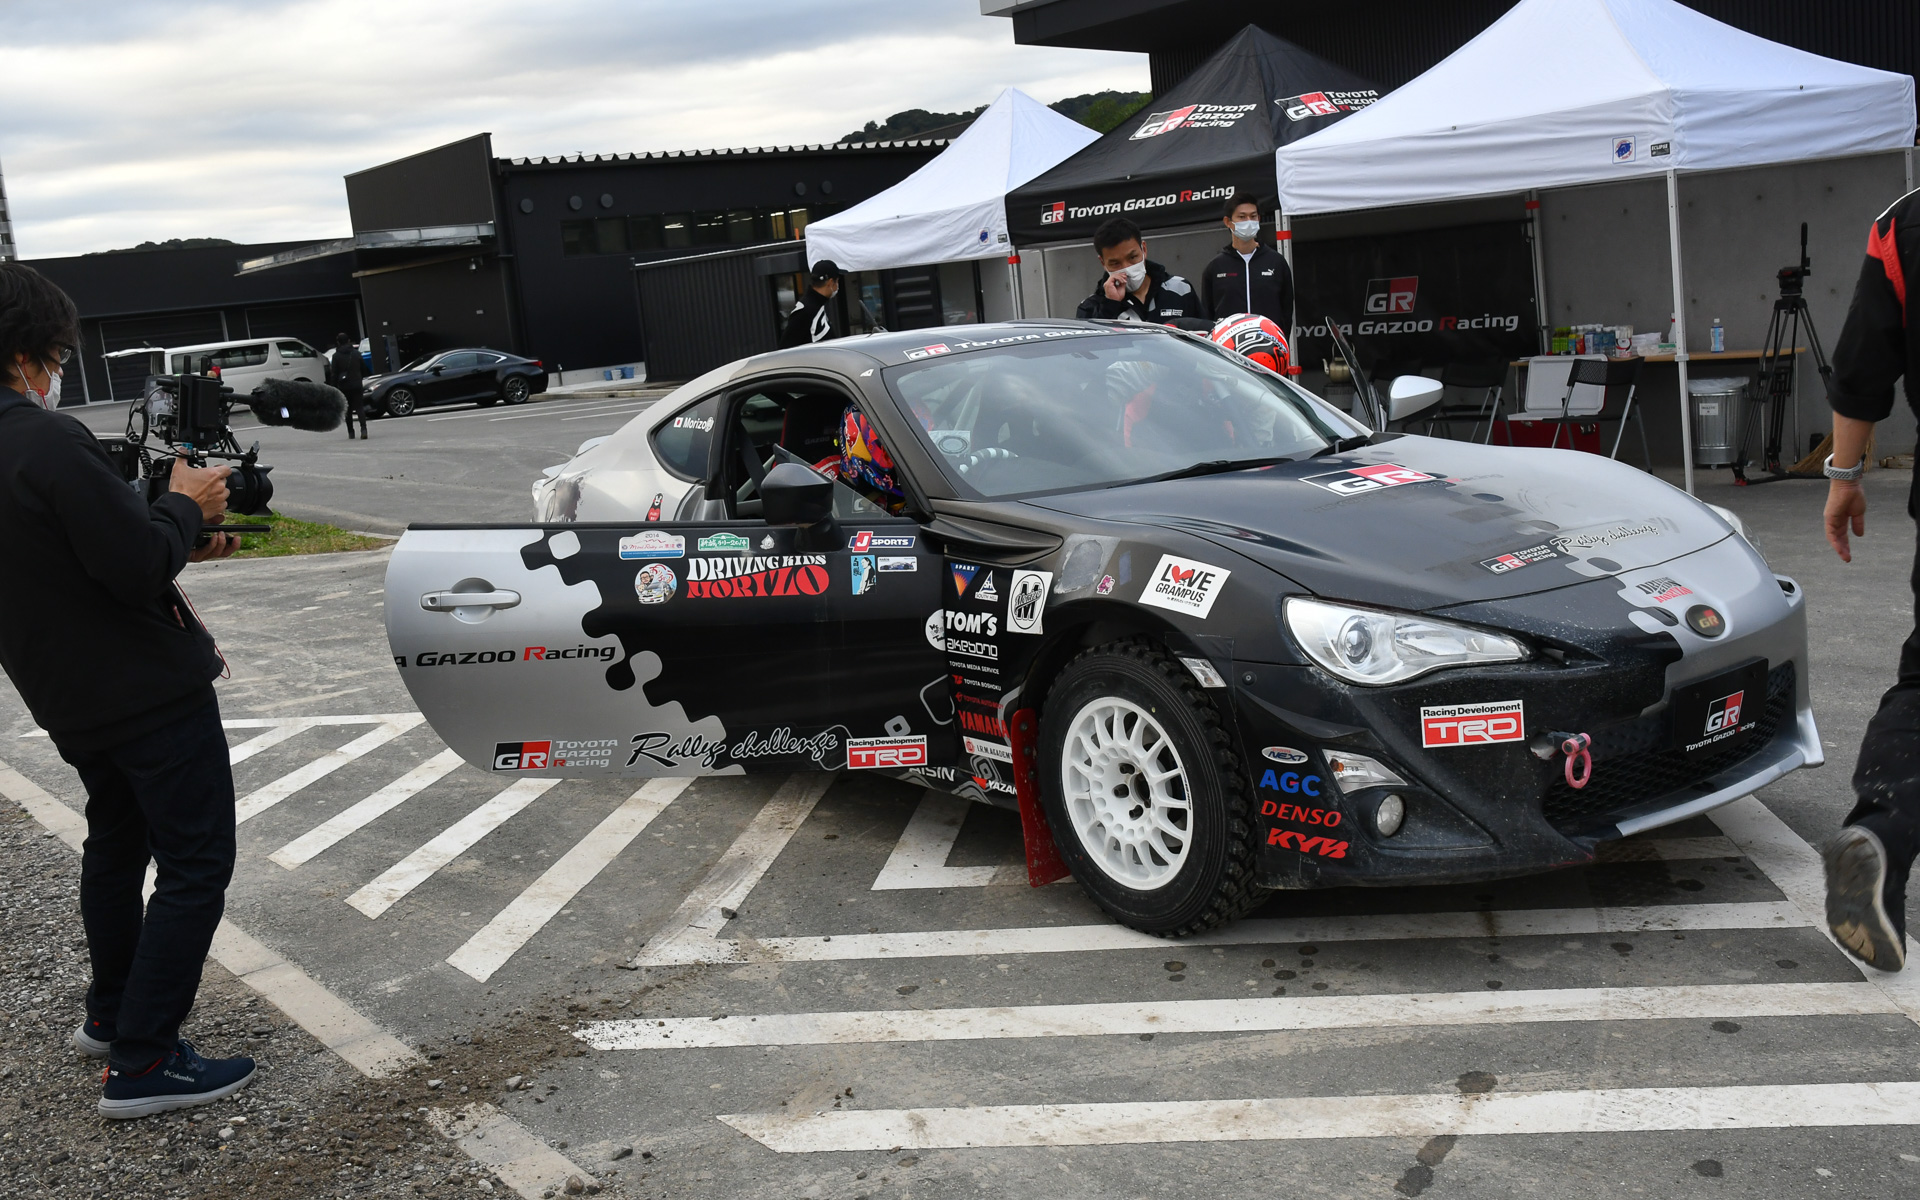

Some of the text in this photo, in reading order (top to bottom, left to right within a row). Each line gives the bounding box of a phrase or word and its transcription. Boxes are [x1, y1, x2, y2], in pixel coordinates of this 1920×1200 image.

[1325, 89, 1379, 99] TOYOTA
[1187, 112, 1245, 120] GAZOO
[1198, 104, 1257, 112] TOYOTA
[1180, 119, 1235, 128] Racing
[1068, 202, 1121, 219] TOYOTA
[1123, 193, 1177, 211] GAZOO
[1179, 185, 1235, 203] Racing
[1367, 291, 1414, 312] GR
[1358, 319, 1433, 335] GAZOO
[1438, 313, 1518, 332] Racing
[910, 344, 950, 358] GR
[954, 334, 1040, 350] TOYOTA
[1043, 328, 1110, 339] GAZOO
[682, 417, 706, 429] Morizo
[1327, 470, 1425, 493] GR
[856, 536, 869, 547] J
[1550, 524, 1658, 553] Rally challenge
[1512, 544, 1549, 557] TOYOTA
[1519, 549, 1551, 560] GAZOO
[1524, 552, 1558, 563] Racing
[686, 556, 779, 581] DRIVING
[782, 555, 827, 567] KIDS
[686, 565, 830, 598] MORIZO
[1155, 582, 1205, 603] GRAMPUS
[945, 610, 998, 636] TOM'S
[416, 650, 516, 667] GAZOO
[523, 644, 616, 662] Racing
[946, 638, 998, 657] akebono
[949, 660, 999, 675] TOYOTA MEDIA SERVICE
[963, 678, 980, 686] TOYOTA
[1423, 703, 1520, 717] Racing Development
[958, 709, 1010, 739] YAMAHA
[1428, 717, 1517, 742] TRD
[556, 739, 618, 749] TOYOTA
[875, 737, 925, 745] Development
[1685, 721, 1755, 751] TOYOTA GAZOO Racing
[554, 749, 612, 758] GAZOO
[625, 727, 838, 768] Rally challenge
[1268, 751, 1305, 761] NEXT
[553, 757, 610, 768] Racing
[852, 748, 922, 766] TRD
[909, 766, 955, 782] AISIN
[1259, 769, 1320, 796] AGC
[1260, 800, 1342, 827] DENSO
[1267, 827, 1349, 859] KYB
[168, 1071, 195, 1083] Columbia
